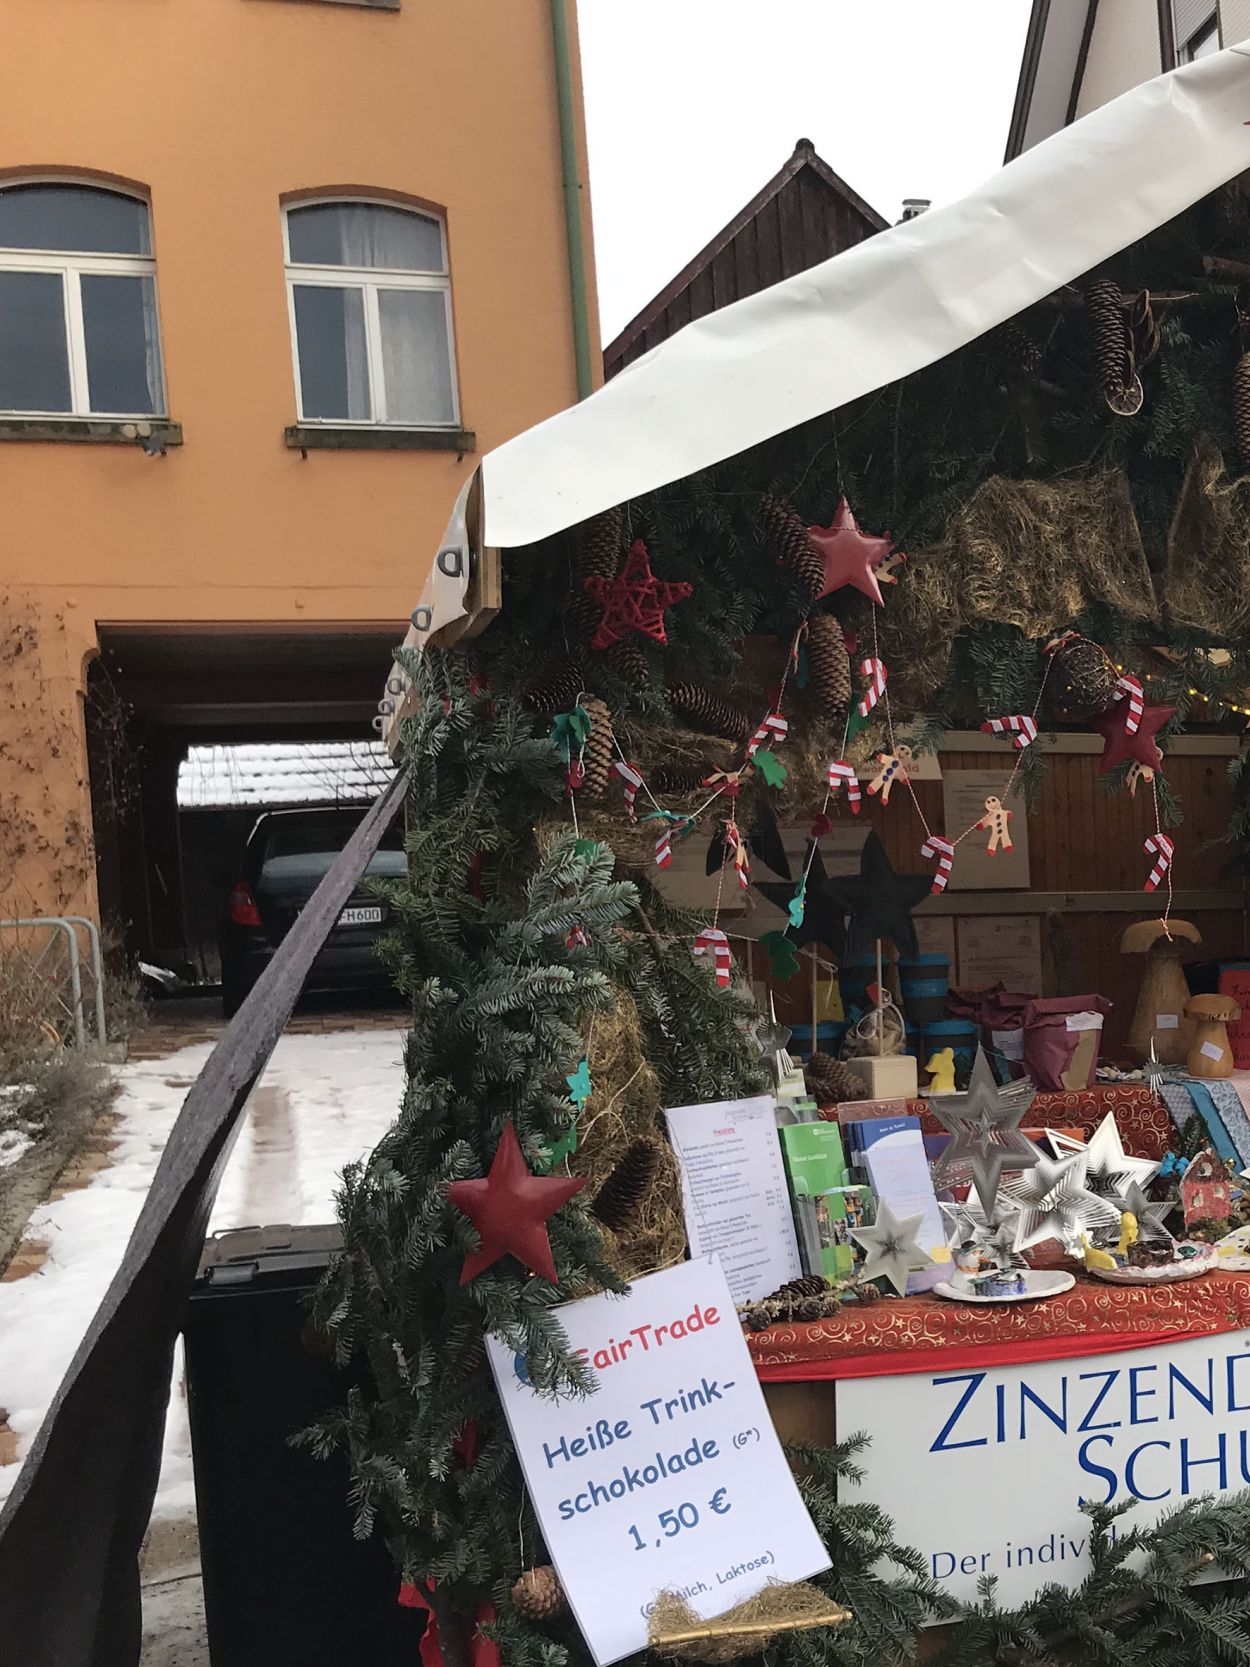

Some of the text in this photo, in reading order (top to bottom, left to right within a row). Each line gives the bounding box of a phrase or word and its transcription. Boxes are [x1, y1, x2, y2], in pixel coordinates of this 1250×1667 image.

[542, 1378, 736, 1468] Heiße Trink-
[558, 1438, 721, 1521] schokolade
[627, 1487, 732, 1551] 1,50 €
[716, 1550, 775, 1585] Laktose)
[931, 1550, 991, 1579] Der
